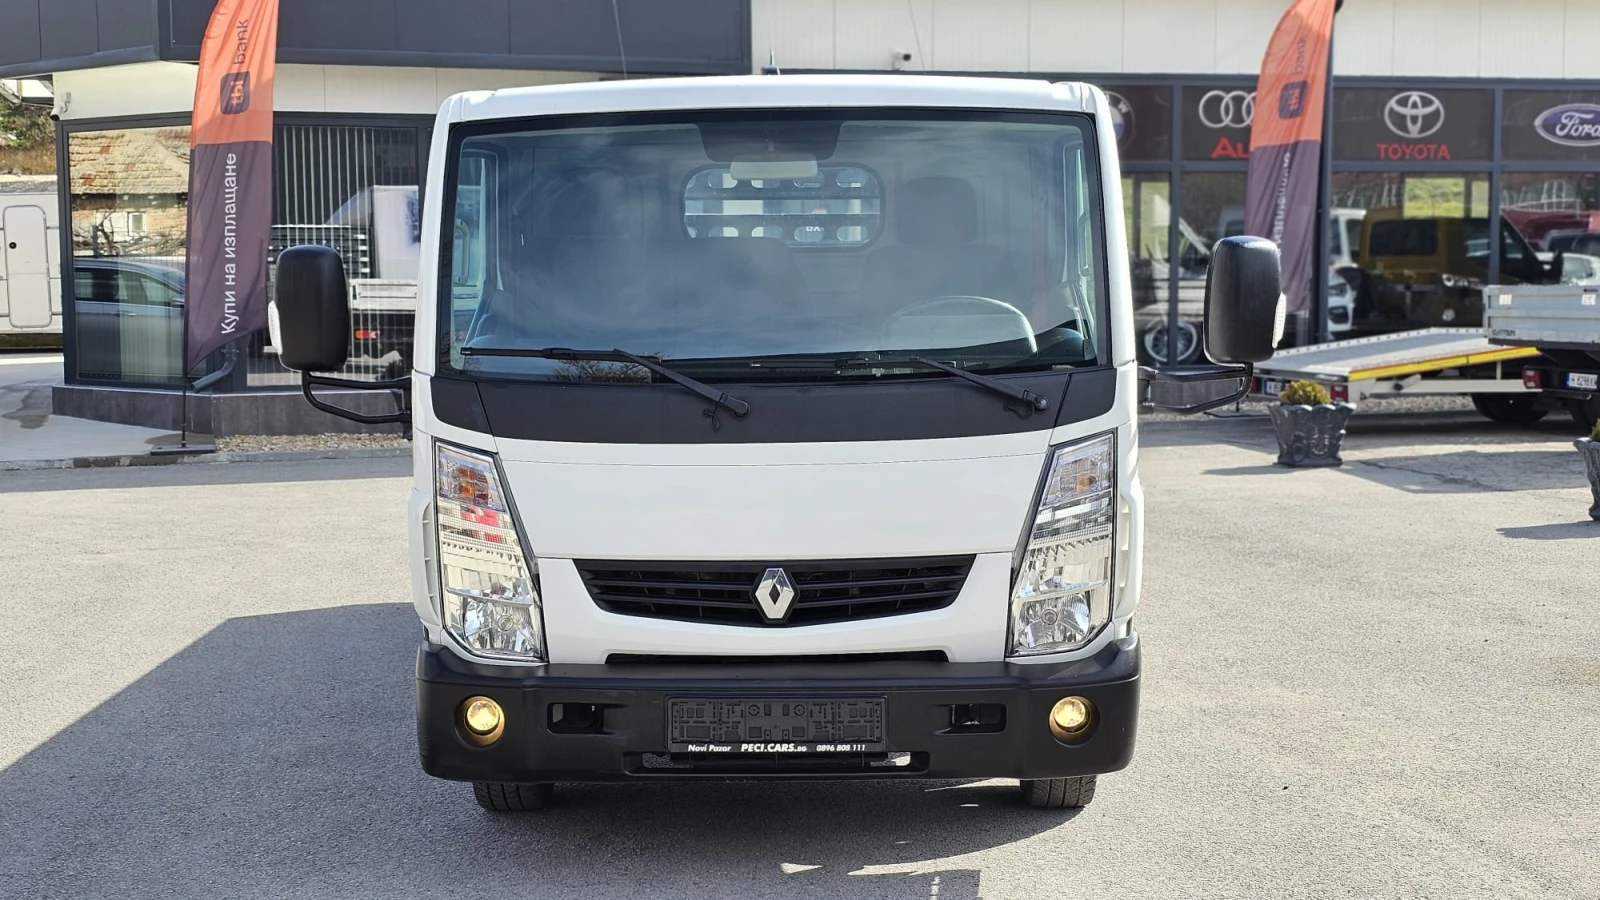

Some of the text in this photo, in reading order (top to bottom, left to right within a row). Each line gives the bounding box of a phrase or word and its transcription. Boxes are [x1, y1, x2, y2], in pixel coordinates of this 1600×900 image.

[230, 18, 248, 106] tbi bank
[1210, 136, 1250, 159] Au
[1376, 143, 1450, 160] TOYOTA
[221, 153, 240, 334] Купи на изплащане
[688, 744, 708, 752] Novi
[709, 744, 732, 752] Pazar
[816, 744, 835, 752] 0896
[836, 744, 851, 752] 808
[853, 744, 866, 752] 111
